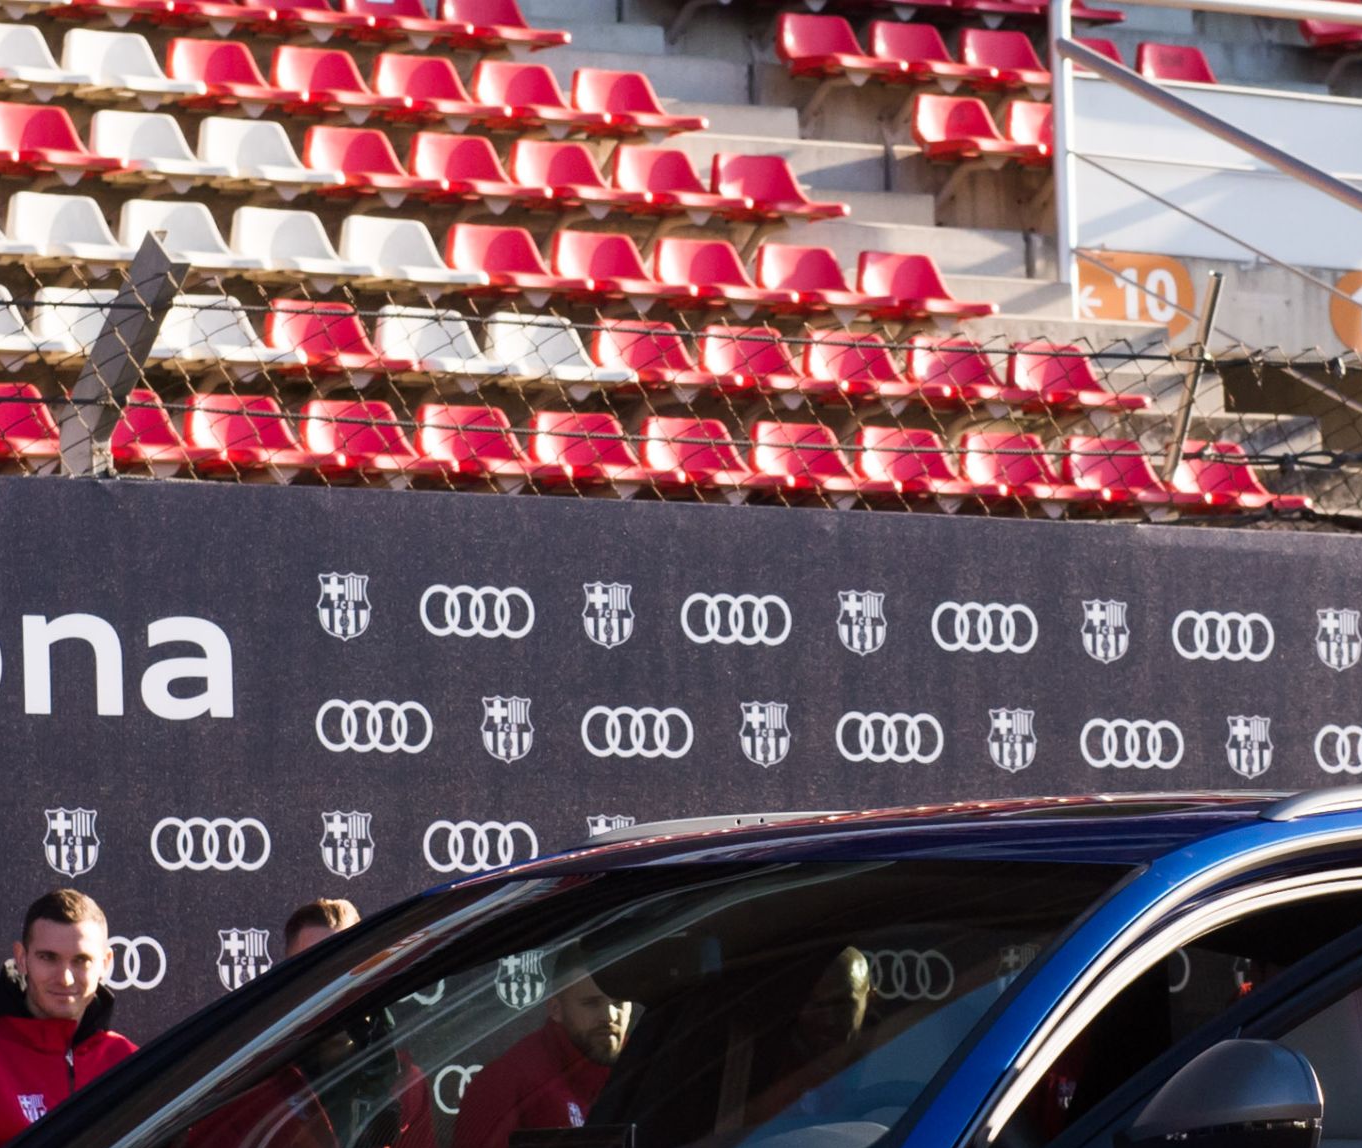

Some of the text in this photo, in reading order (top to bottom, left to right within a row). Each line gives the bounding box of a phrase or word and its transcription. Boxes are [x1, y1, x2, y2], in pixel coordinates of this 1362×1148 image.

[1114, 267, 1178, 322] 10
[334, 600, 353, 609] FCB
[598, 609, 618, 618] FCB
[852, 617, 871, 626] FCB
[1097, 626, 1114, 634] FCB
[498, 723, 517, 732] FCB
[755, 728, 774, 737] FCB
[1003, 734, 1022, 743] FCB
[61, 836, 82, 845] FCB
[338, 839, 357, 848] FCB
[234, 956, 254, 965] FCB
